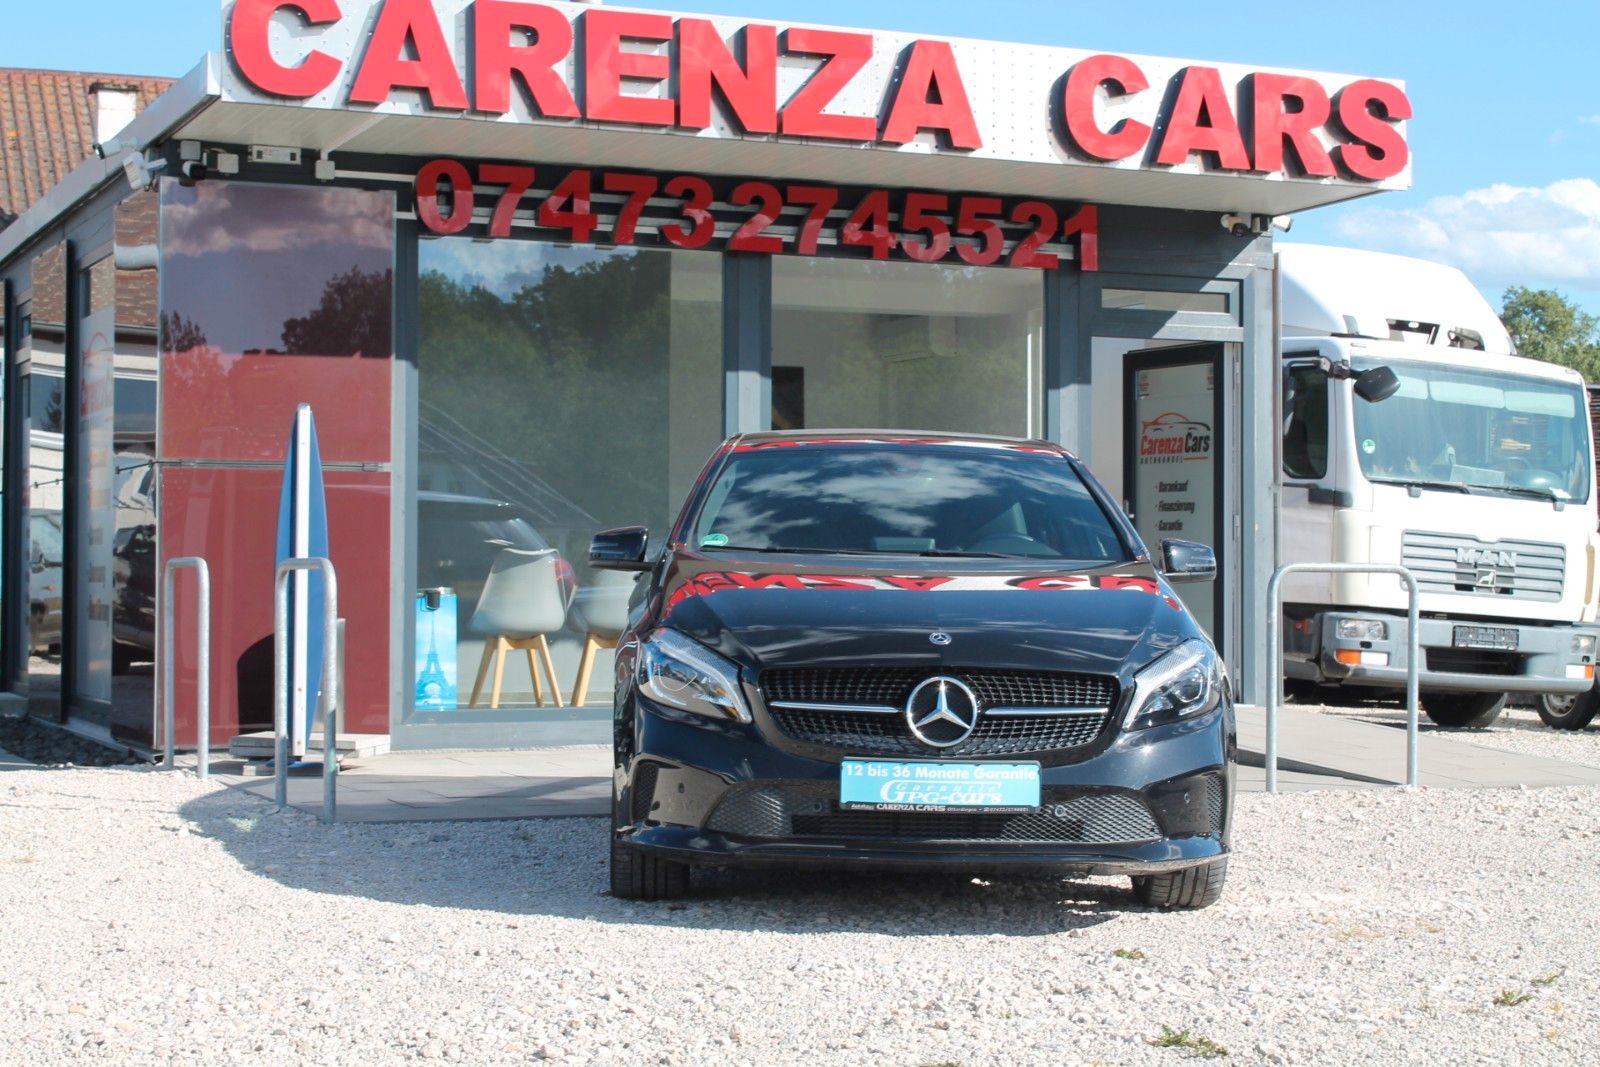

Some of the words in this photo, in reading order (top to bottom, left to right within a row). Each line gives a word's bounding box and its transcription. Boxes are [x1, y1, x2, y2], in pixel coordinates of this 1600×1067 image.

[229, 0, 982, 150] CARENZA
[1060, 54, 1413, 181] CARS
[1456, 547, 1517, 568] MAN
[846, 765, 864, 777] 12
[868, 764, 888, 778] bis
[892, 766, 911, 778] 36
[915, 766, 970, 780] Monate
[974, 767, 1036, 780] Garantie
[916, 804, 946, 812] CARS
